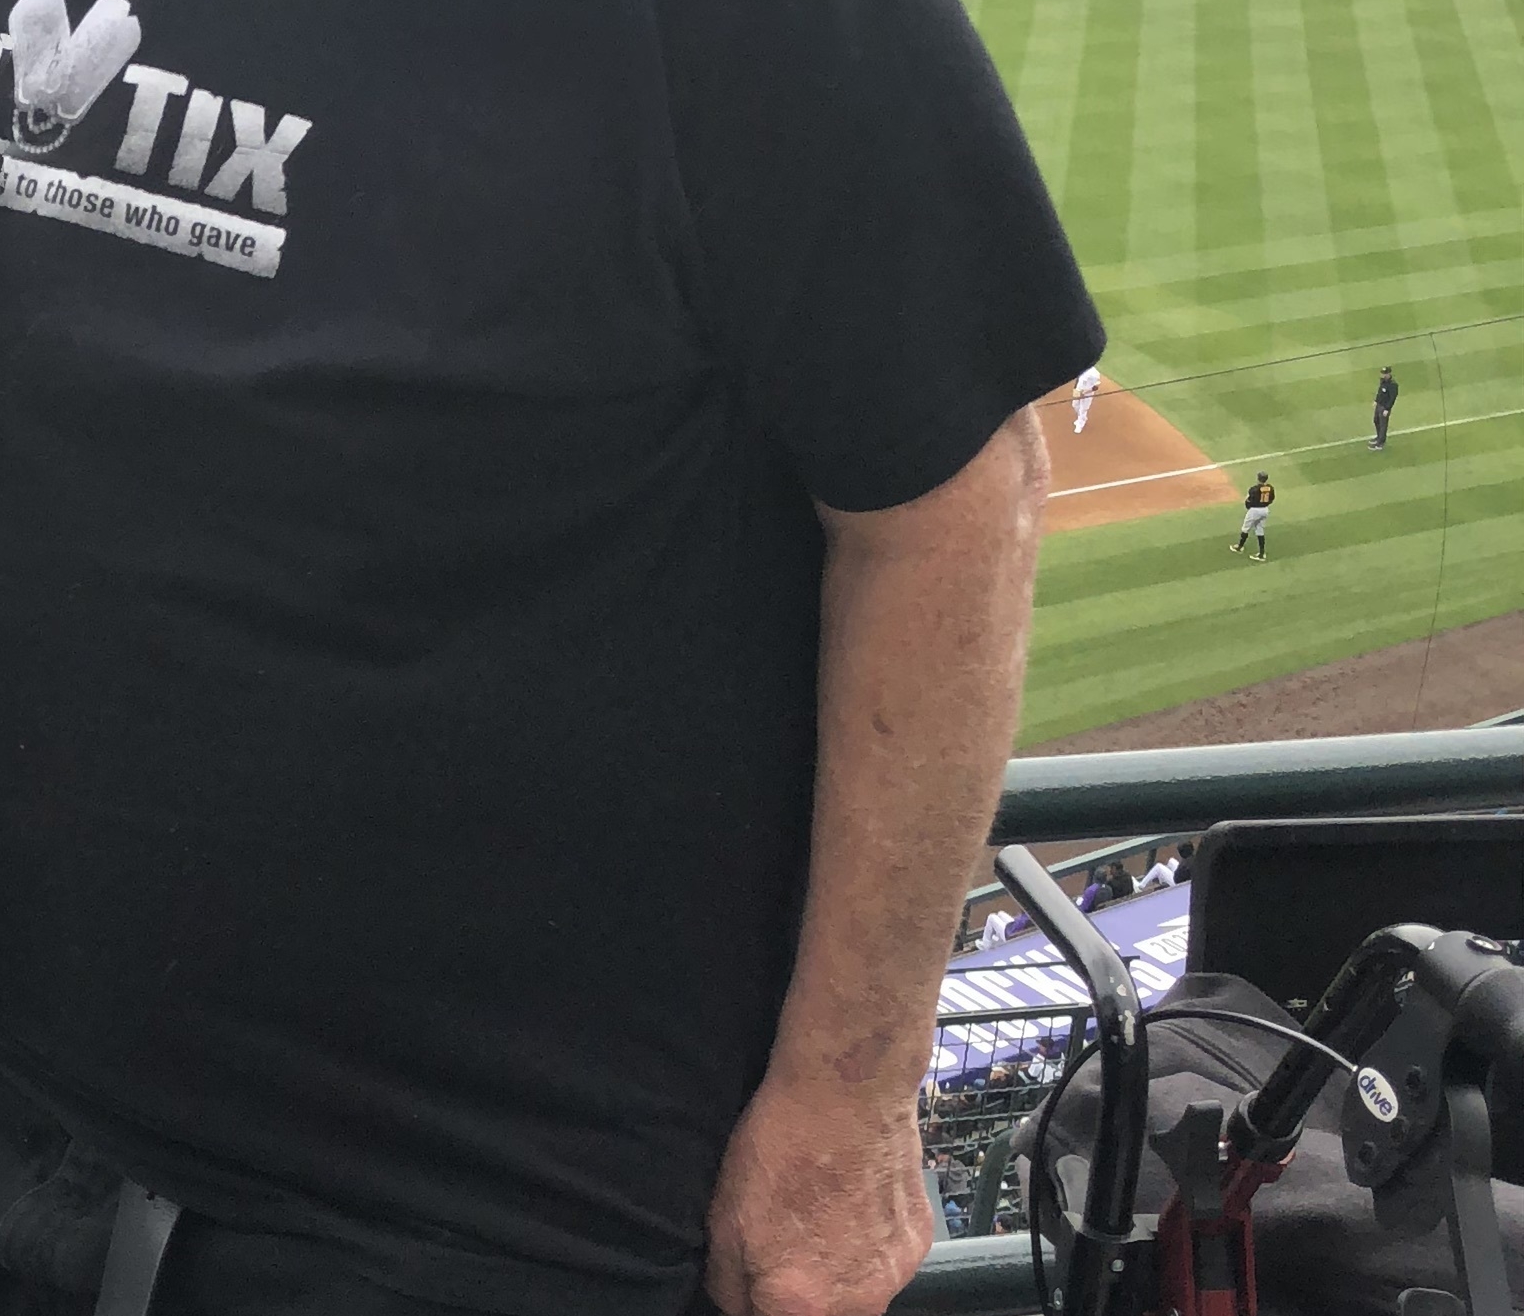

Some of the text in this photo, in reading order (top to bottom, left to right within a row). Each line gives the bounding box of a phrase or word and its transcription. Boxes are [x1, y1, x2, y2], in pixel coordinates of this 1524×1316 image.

[113, 62, 313, 216] TIX
[16, 173, 39, 198] to
[43, 177, 114, 219] those
[124, 200, 180, 237] who
[189, 220, 257, 259] gave
[1359, 1075, 1393, 1116] drive
